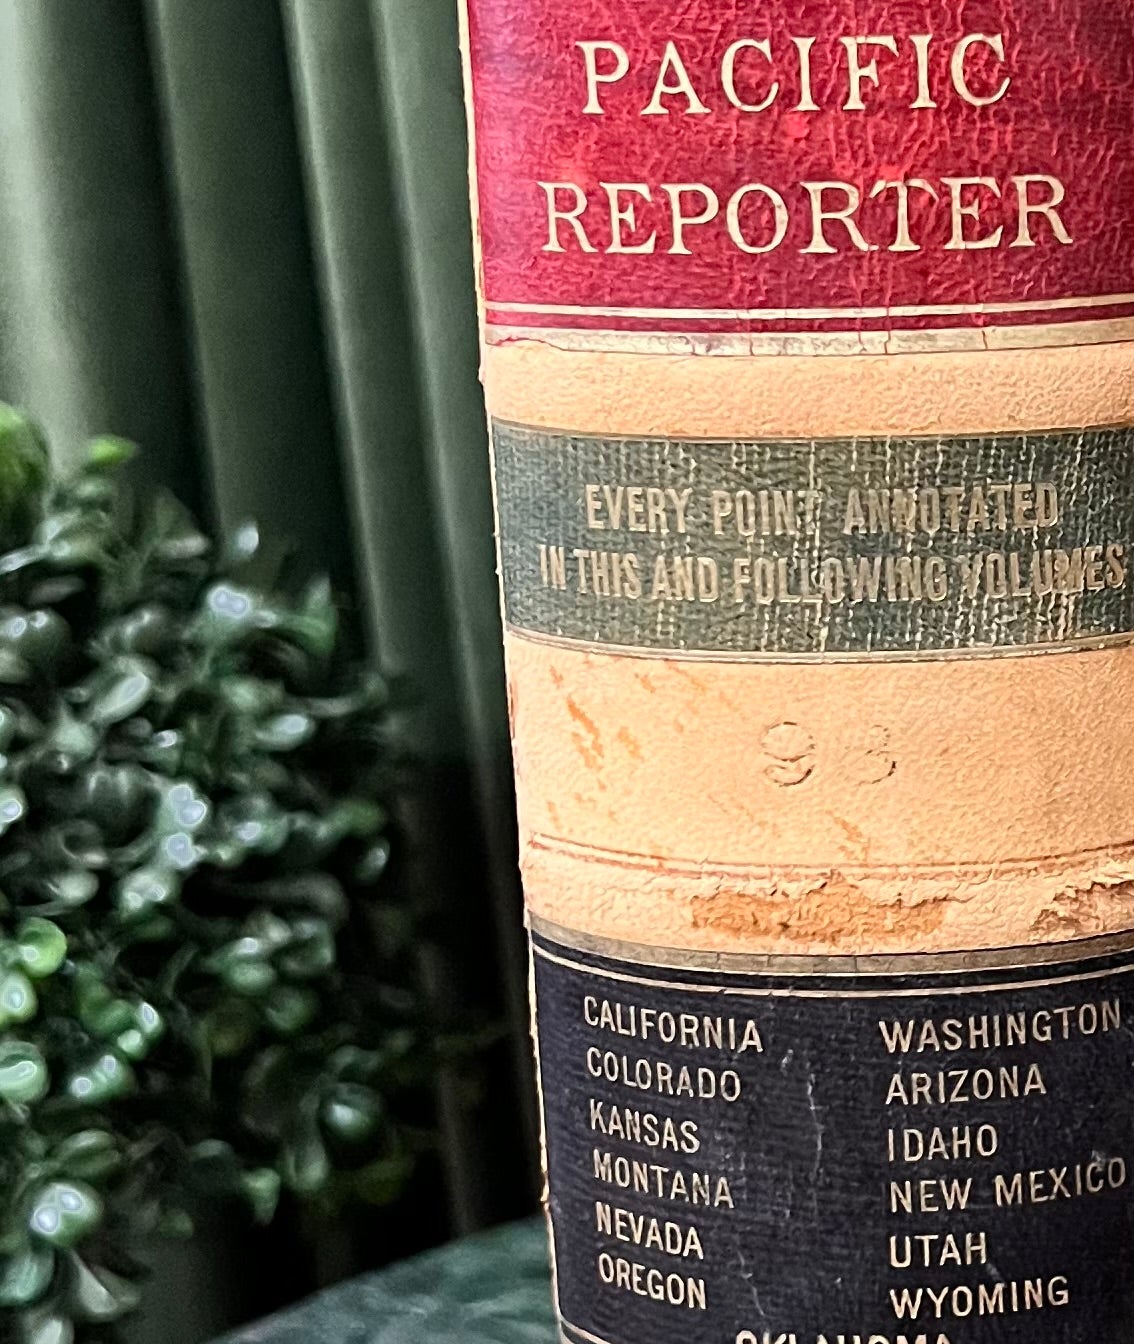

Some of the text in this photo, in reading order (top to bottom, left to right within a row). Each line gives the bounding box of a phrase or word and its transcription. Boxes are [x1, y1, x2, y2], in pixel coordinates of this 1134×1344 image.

[574, 32, 1012, 116] PACIFIC
[537, 174, 1074, 256] REPORTER
[584, 482, 1059, 537] EVERY POINT ANNOTATED
[537, 543, 1126, 605] IN THIS AND FOLLOWING VOLUMES
[584, 994, 764, 1055] CALIFORNIA
[878, 997, 1122, 1055] WASHINGTON
[586, 1046, 742, 1103] COLORADO
[885, 1063, 1048, 1106] ARIZONA
[589, 1098, 701, 1155] KANSAS
[888, 1124, 999, 1163] IDAHO
[592, 1148, 735, 1209] MONTANA
[889, 1157, 1128, 1214] NEW MEXICO
[595, 1201, 705, 1261] NEVADA
[889, 1232, 988, 1269] UTAH
[598, 1253, 708, 1311] OREGON
[889, 1276, 1071, 1320] WYOMING
